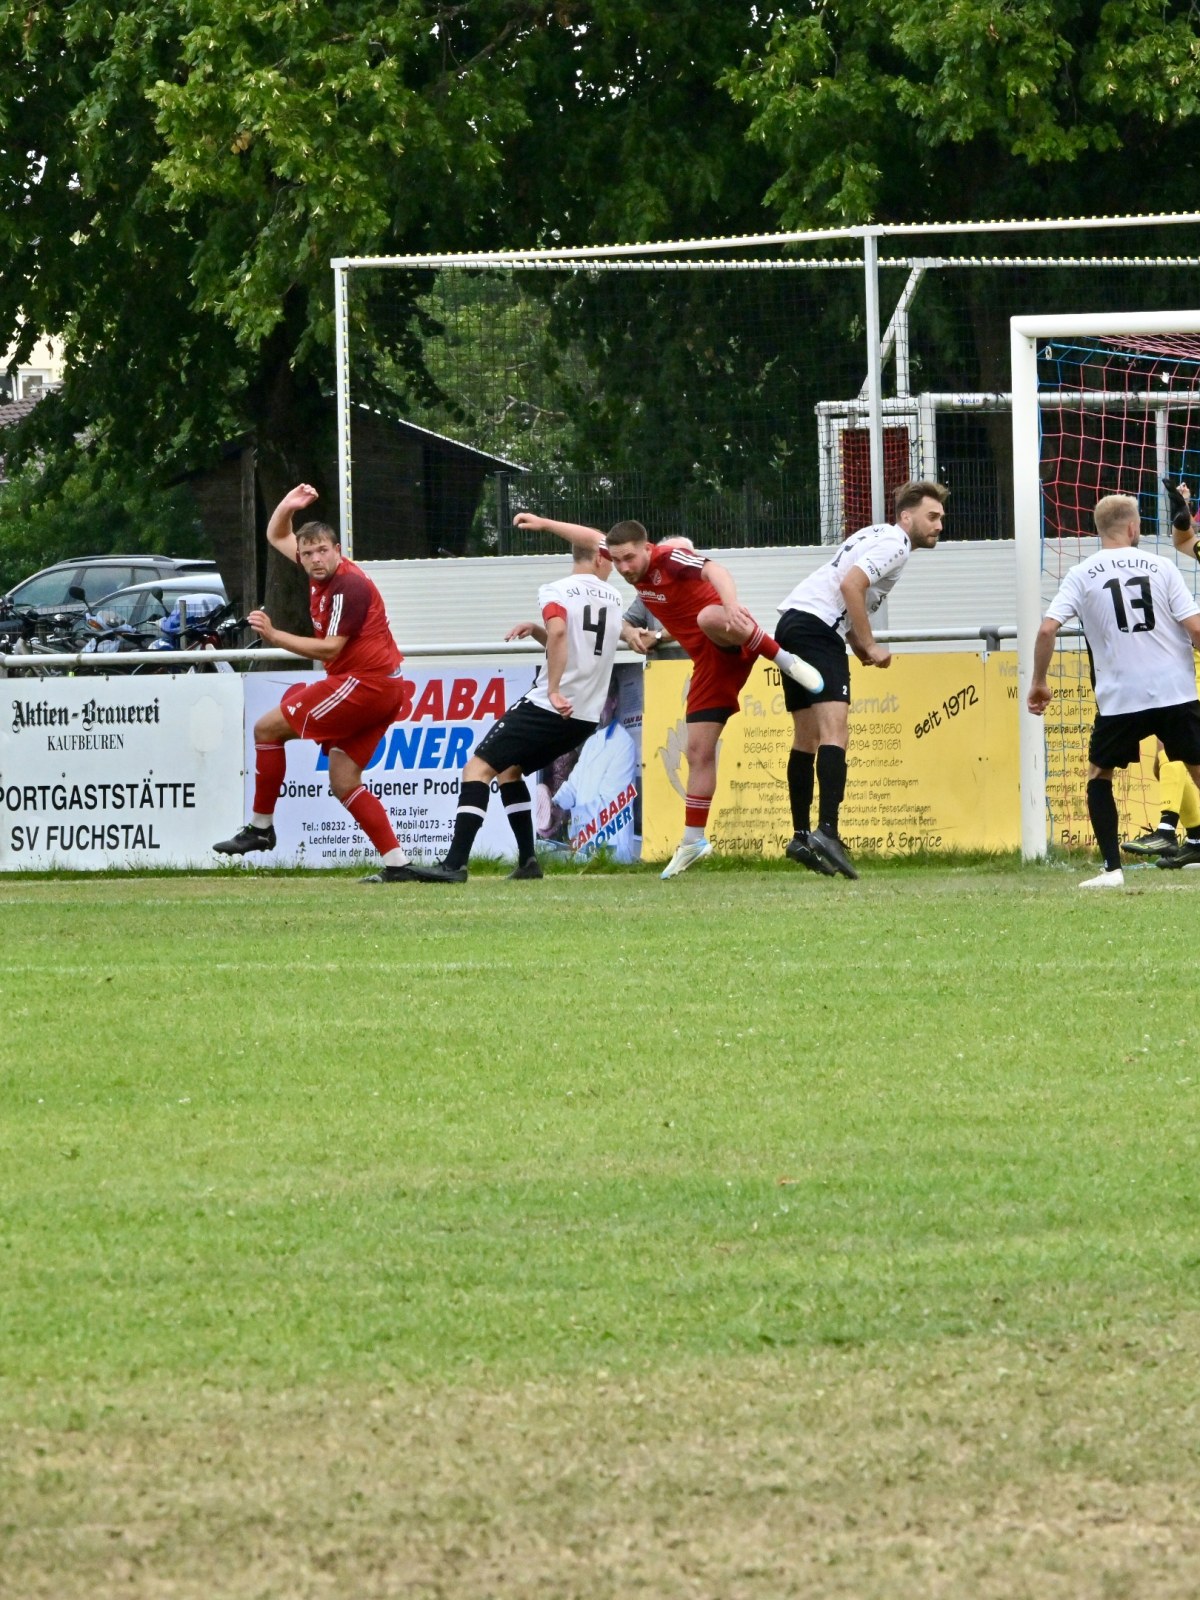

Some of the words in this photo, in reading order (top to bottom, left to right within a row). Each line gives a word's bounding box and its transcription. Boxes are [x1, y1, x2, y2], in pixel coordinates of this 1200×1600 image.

[1111, 559, 1159, 574] IGLING
[1102, 575, 1156, 633] 13
[583, 604, 607, 656] 4
[842, 685, 848, 695] 2
[1077, 685, 1092, 698] für
[914, 710, 942, 739] seit
[942, 684, 979, 719] 1972
[1049, 704, 1063, 717] 30
[869, 722, 903, 734] 931650
[47, 734, 124, 751] KAUFBEUREN
[871, 738, 901, 751] 931651
[279, 779, 323, 798] Döner
[1045, 782, 1078, 796] empinski
[390, 806, 407, 817] Riza
[599, 783, 637, 827] BABA
[302, 822, 319, 832] Tel.:
[321, 821, 346, 831] 08232
[11, 826, 39, 851] SV
[46, 824, 160, 851] FUCHSTAL
[309, 834, 350, 845] Lechfelder
[352, 834, 367, 844] Str.
[413, 833, 455, 843] Untermeit
[709, 834, 764, 854] Beratung
[841, 834, 884, 852] ontage
[886, 832, 896, 848] &
[899, 831, 943, 848] Service
[1061, 829, 1081, 846] Bei
[322, 849, 337, 859] und
[339, 848, 347, 858] in
[348, 848, 362, 858] der
[424, 848, 432, 857] in
